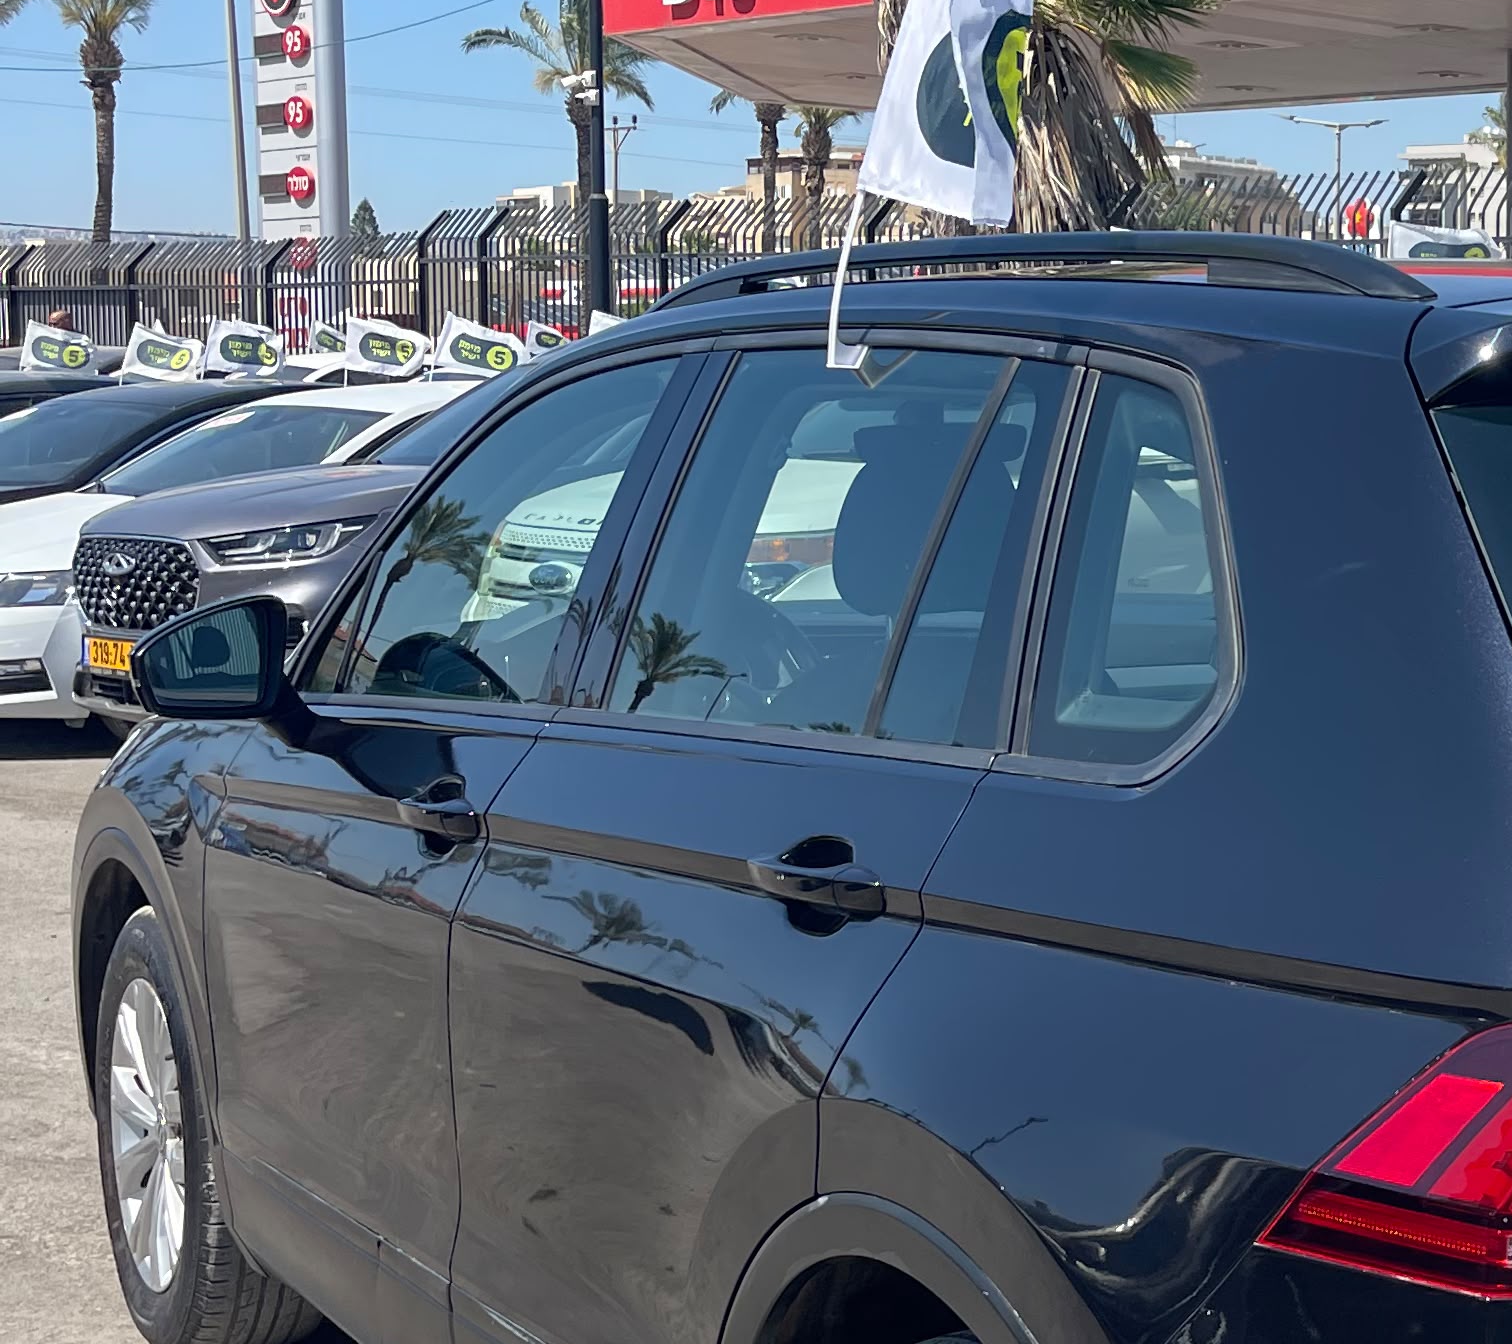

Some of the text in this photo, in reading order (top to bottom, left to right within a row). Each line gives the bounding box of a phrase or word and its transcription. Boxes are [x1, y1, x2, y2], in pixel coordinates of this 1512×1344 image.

[285, 30, 302, 53] 95
[288, 101, 303, 124] 95
[493, 350, 506, 366] 5
